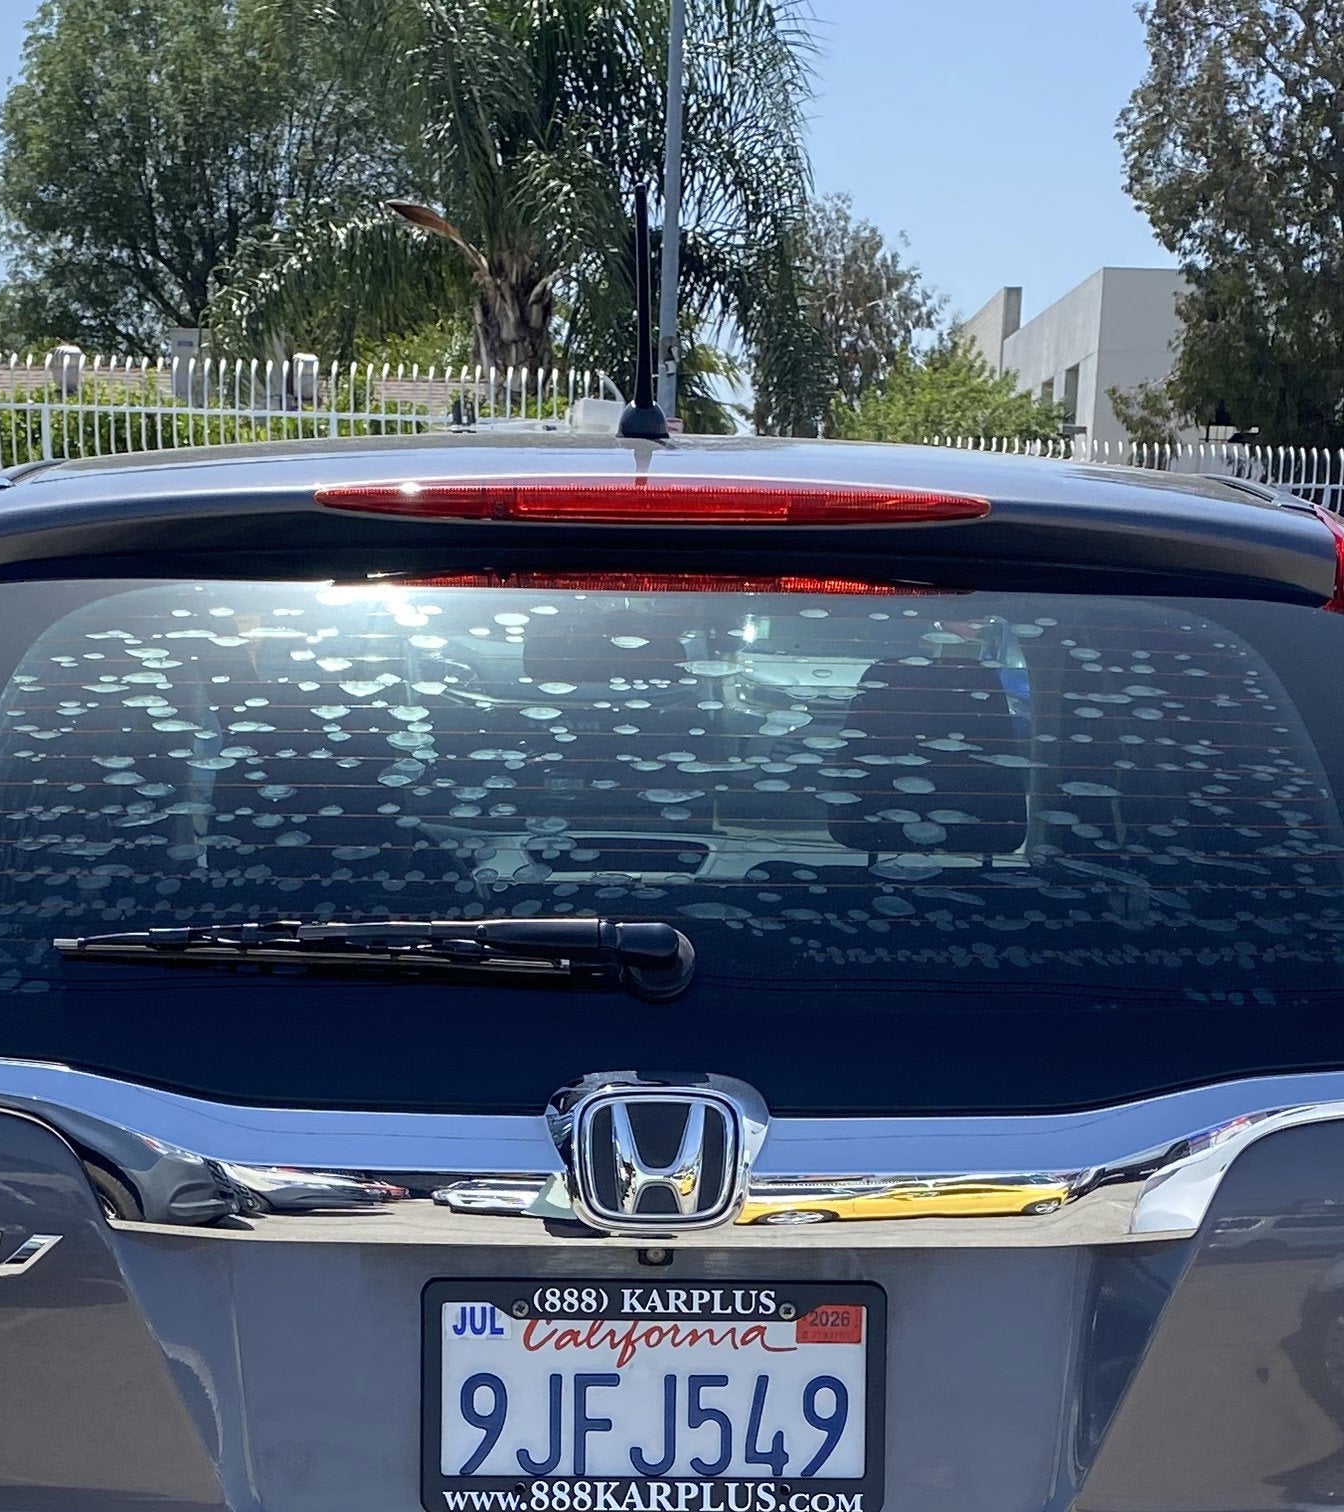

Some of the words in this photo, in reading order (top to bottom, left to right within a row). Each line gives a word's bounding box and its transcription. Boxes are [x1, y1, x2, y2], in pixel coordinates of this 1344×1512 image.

[533, 1288, 609, 1314] (888)
[621, 1289, 776, 1315] KARPLUS
[452, 1307, 504, 1335] JUL
[523, 1319, 797, 1368] California
[809, 1310, 850, 1328] 2026
[460, 1372, 849, 1476] 9JFJ549
